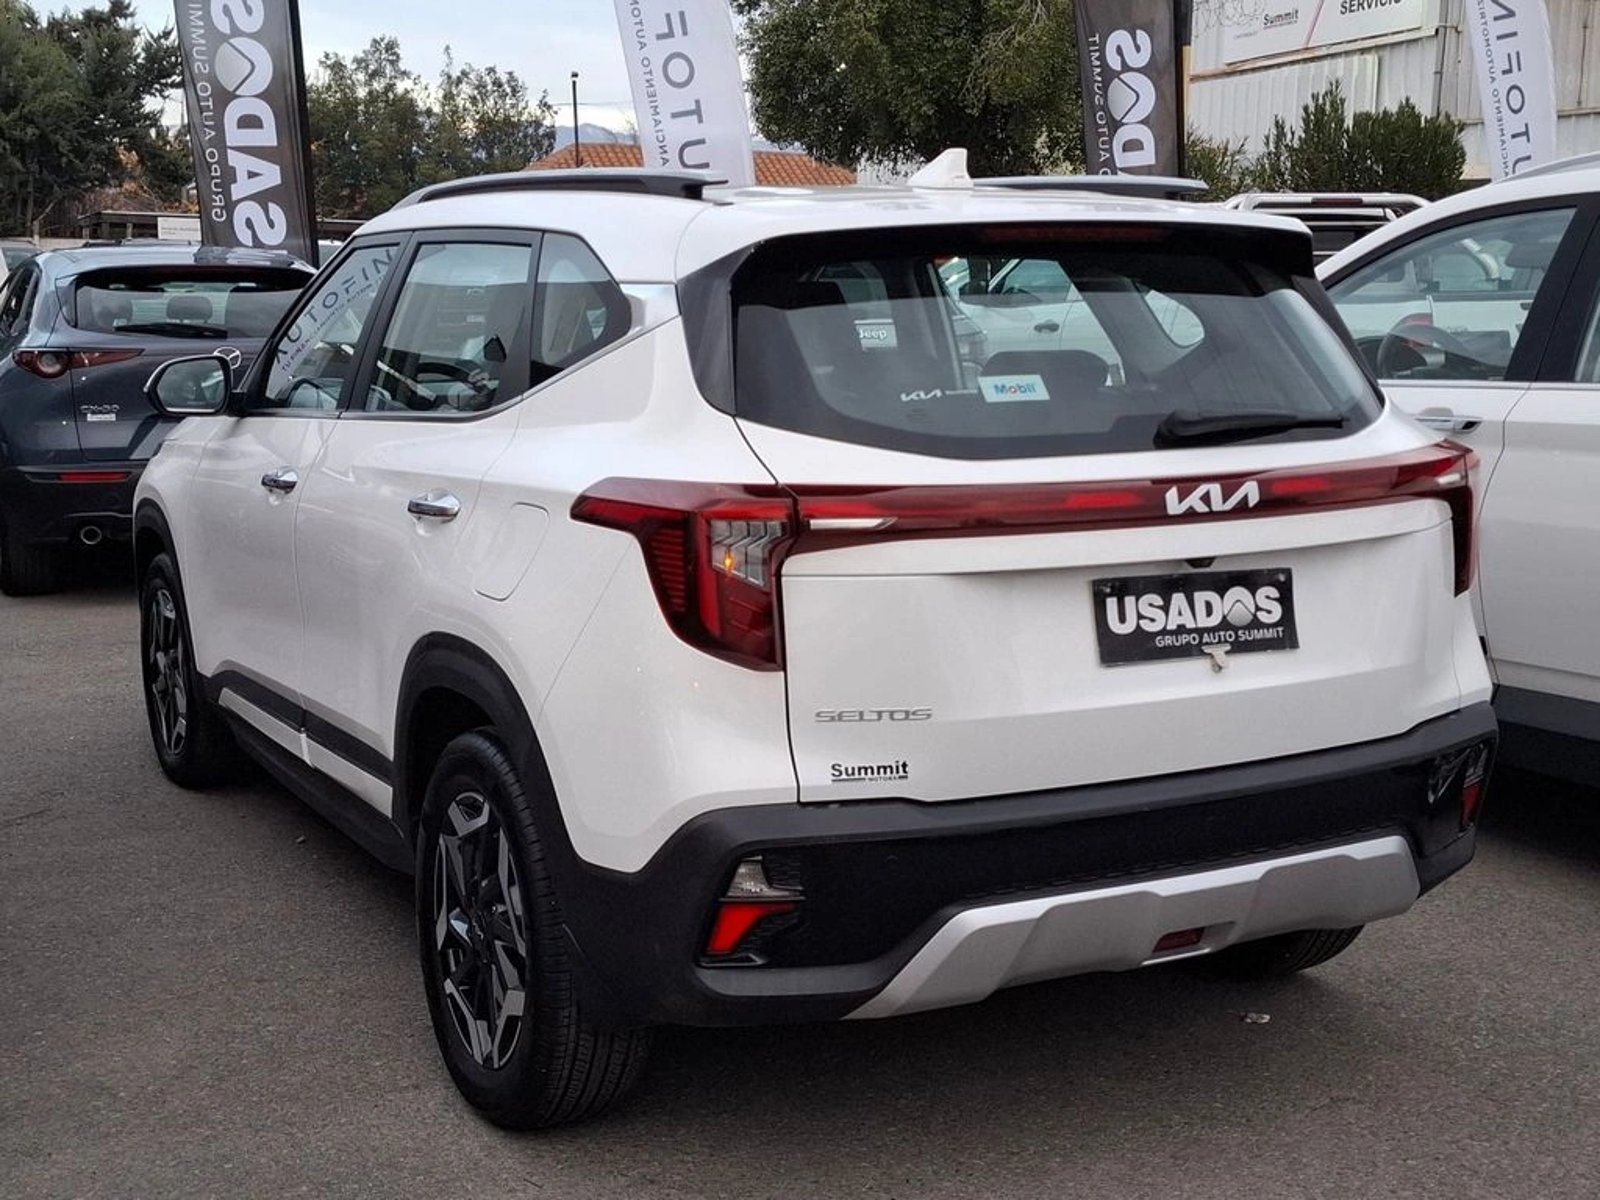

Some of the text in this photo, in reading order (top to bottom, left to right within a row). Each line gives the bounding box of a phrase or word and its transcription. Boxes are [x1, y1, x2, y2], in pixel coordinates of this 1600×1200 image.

[859, 328, 887, 340] Jeep
[1165, 480, 1260, 515] KIA
[1105, 586, 1283, 635] USADOS
[1155, 626, 1285, 647] GRUPO AUTO SUMMIT
[815, 708, 932, 722] SELTOS
[831, 760, 908, 777] Summit
